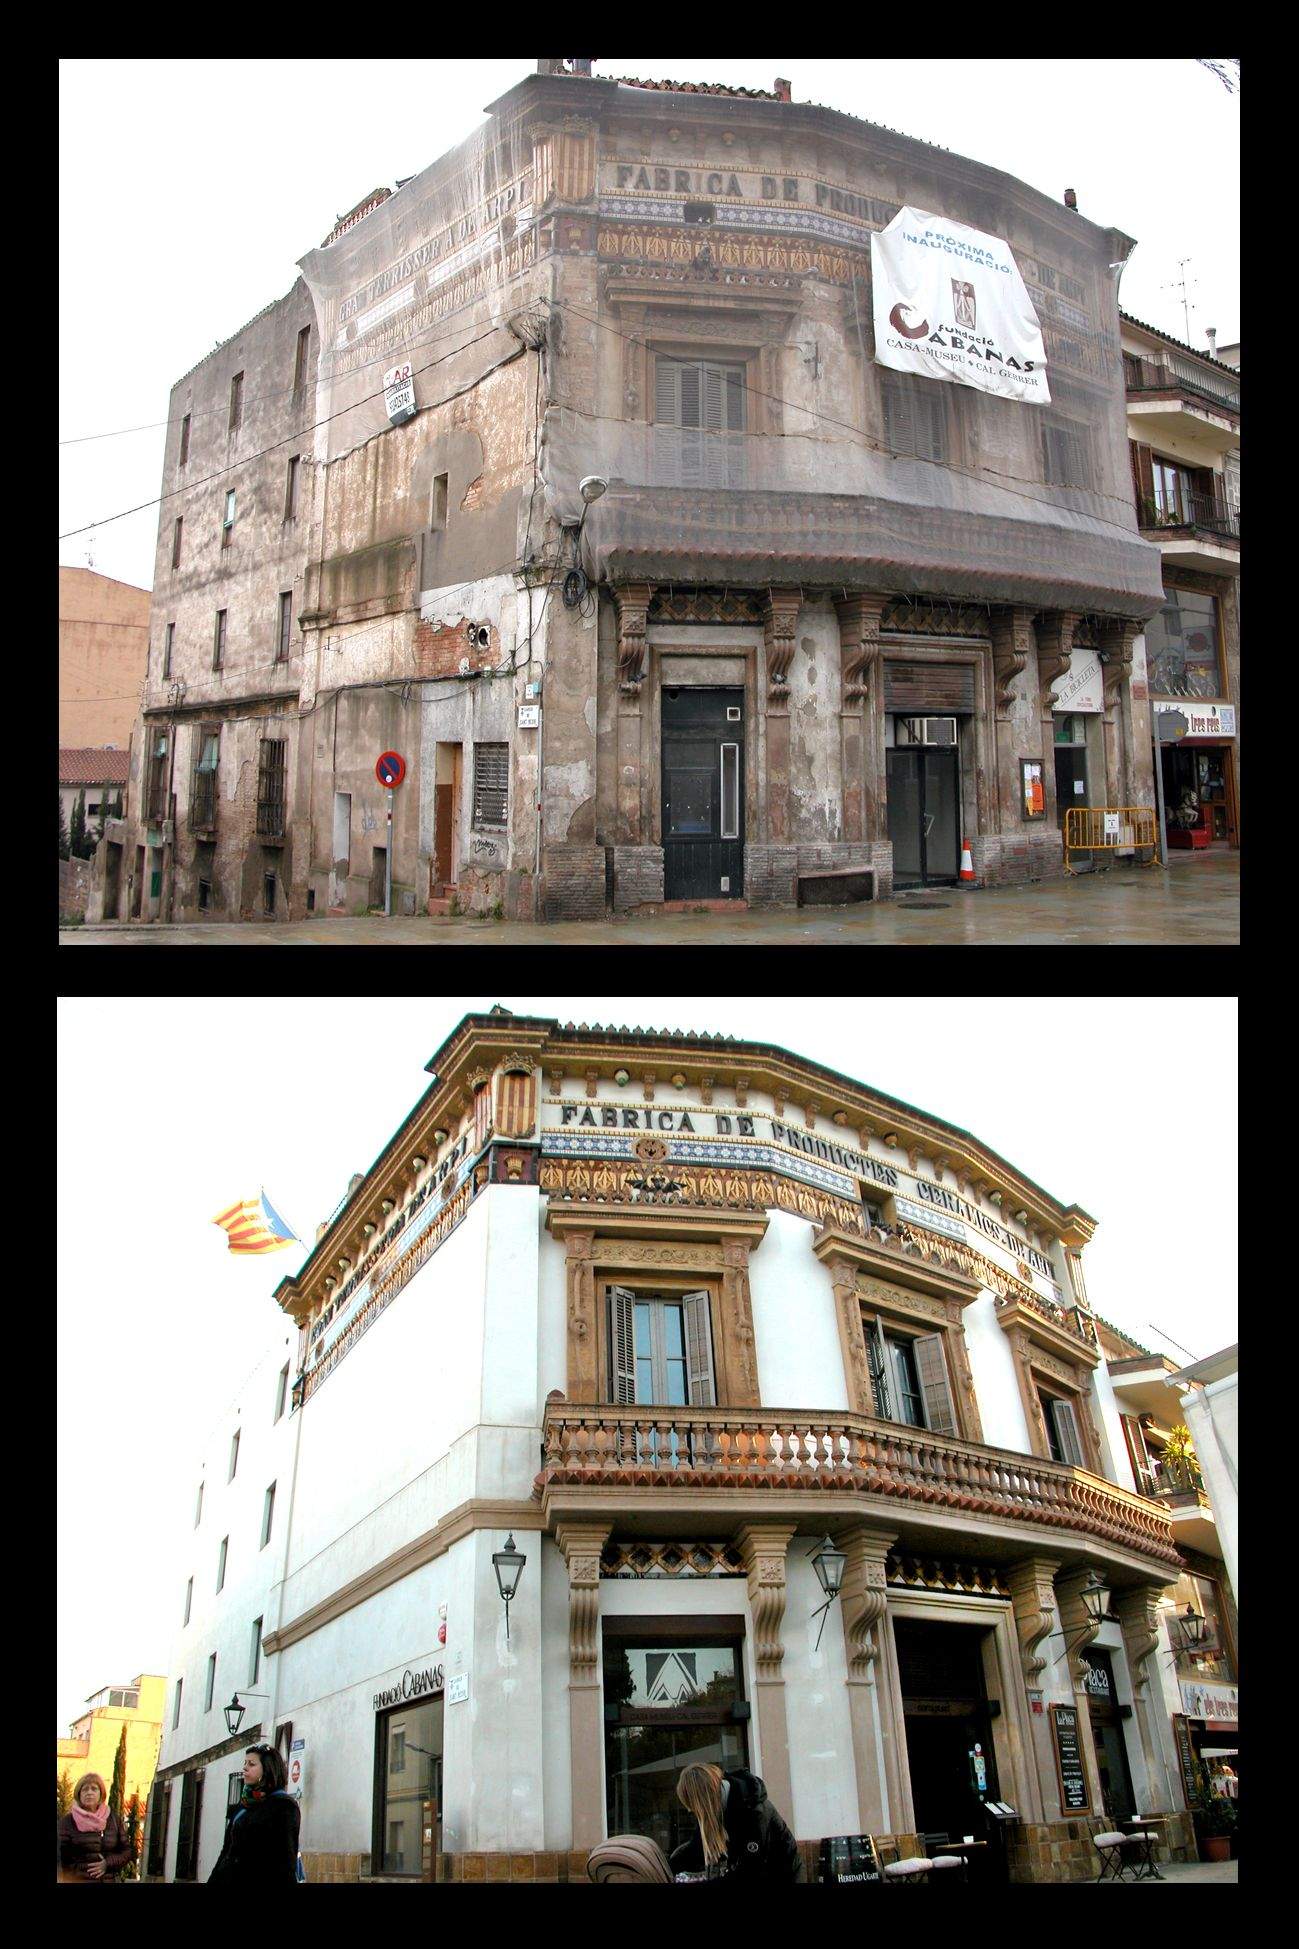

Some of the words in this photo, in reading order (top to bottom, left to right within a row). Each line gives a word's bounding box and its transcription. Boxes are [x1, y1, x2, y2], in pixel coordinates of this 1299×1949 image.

[761, 175, 799, 201] DE
[886, 338, 966, 366] CASA-MUSEU
[976, 362, 996, 376] CAL
[998, 368, 1039, 387] GERRER
[561, 1105, 696, 1134] FABRICA
[716, 1114, 755, 1137] DE
[771, 1121, 899, 1188] PRODUCTES
[402, 1663, 445, 1699] CABANAS
